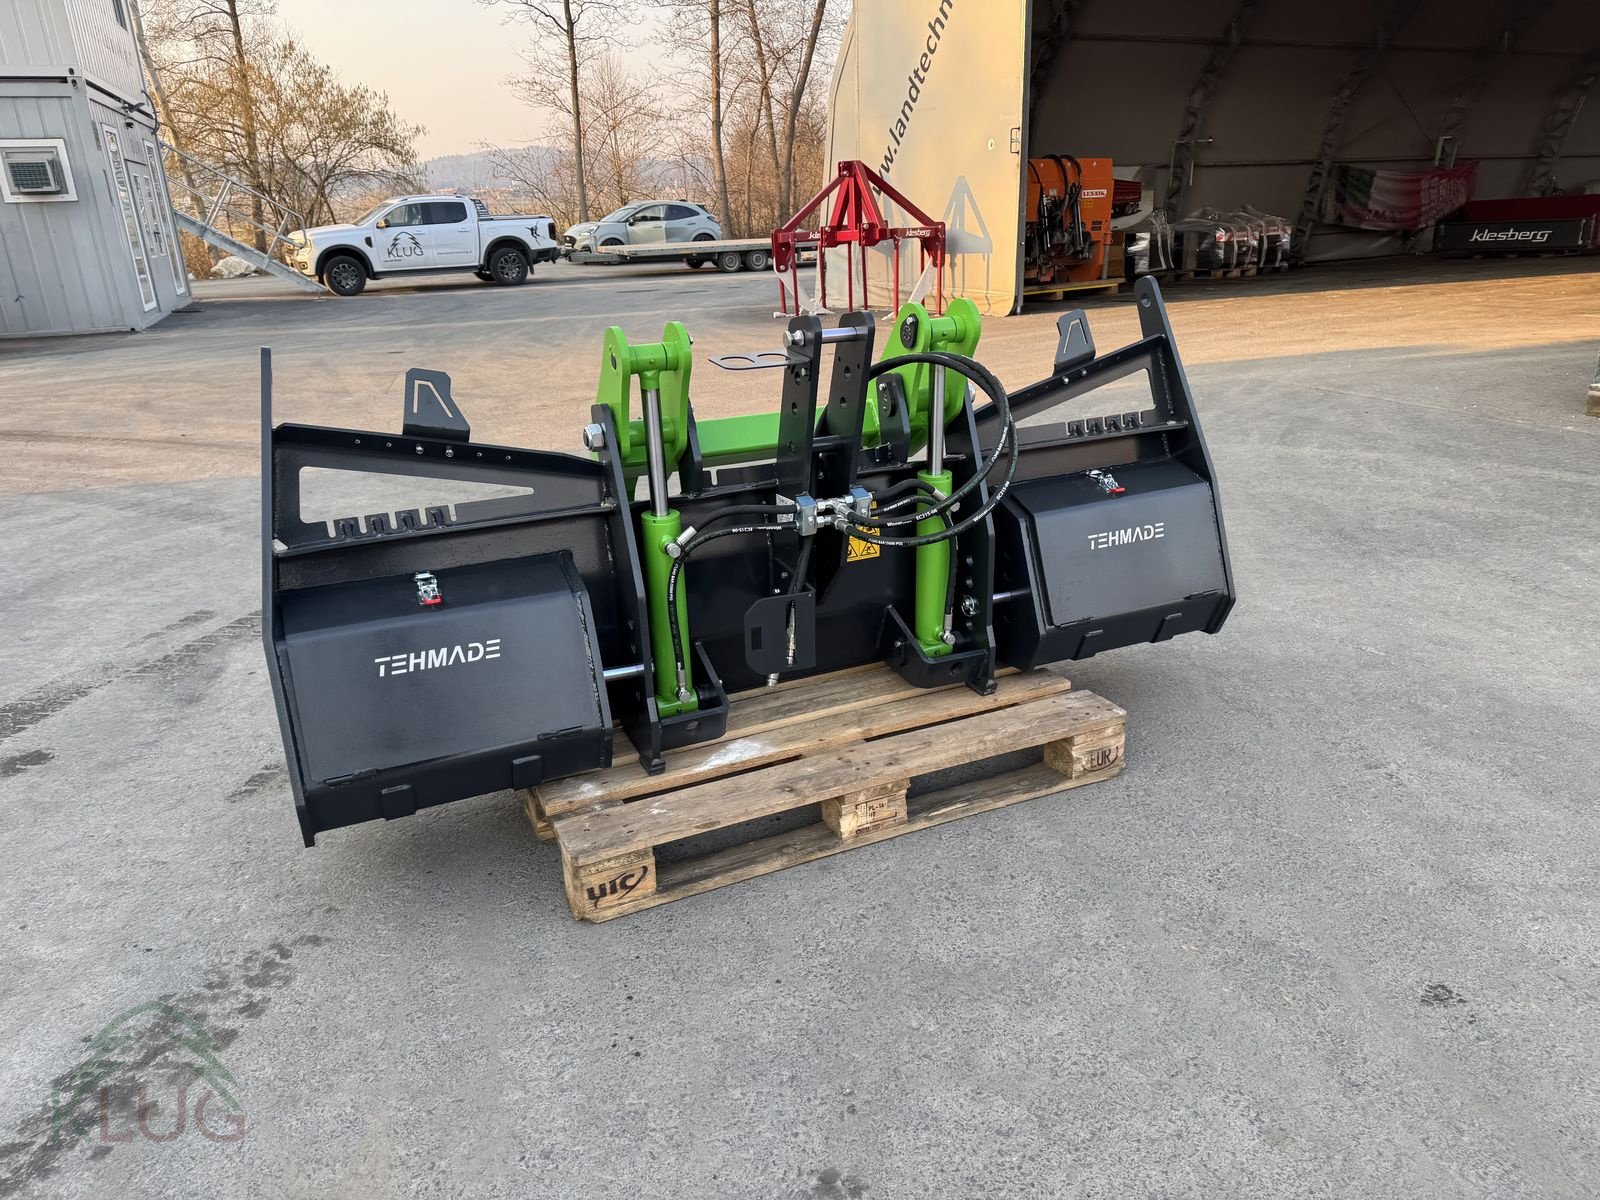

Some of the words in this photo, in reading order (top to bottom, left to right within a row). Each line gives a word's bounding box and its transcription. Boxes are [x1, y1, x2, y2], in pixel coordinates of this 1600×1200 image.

[1469, 228, 1553, 243] klesberg
[387, 246, 424, 258] KLUG
[1088, 522, 1164, 550] TEHMADE
[375, 638, 501, 677] TEHMADE
[1090, 748, 1112, 769] EUR
